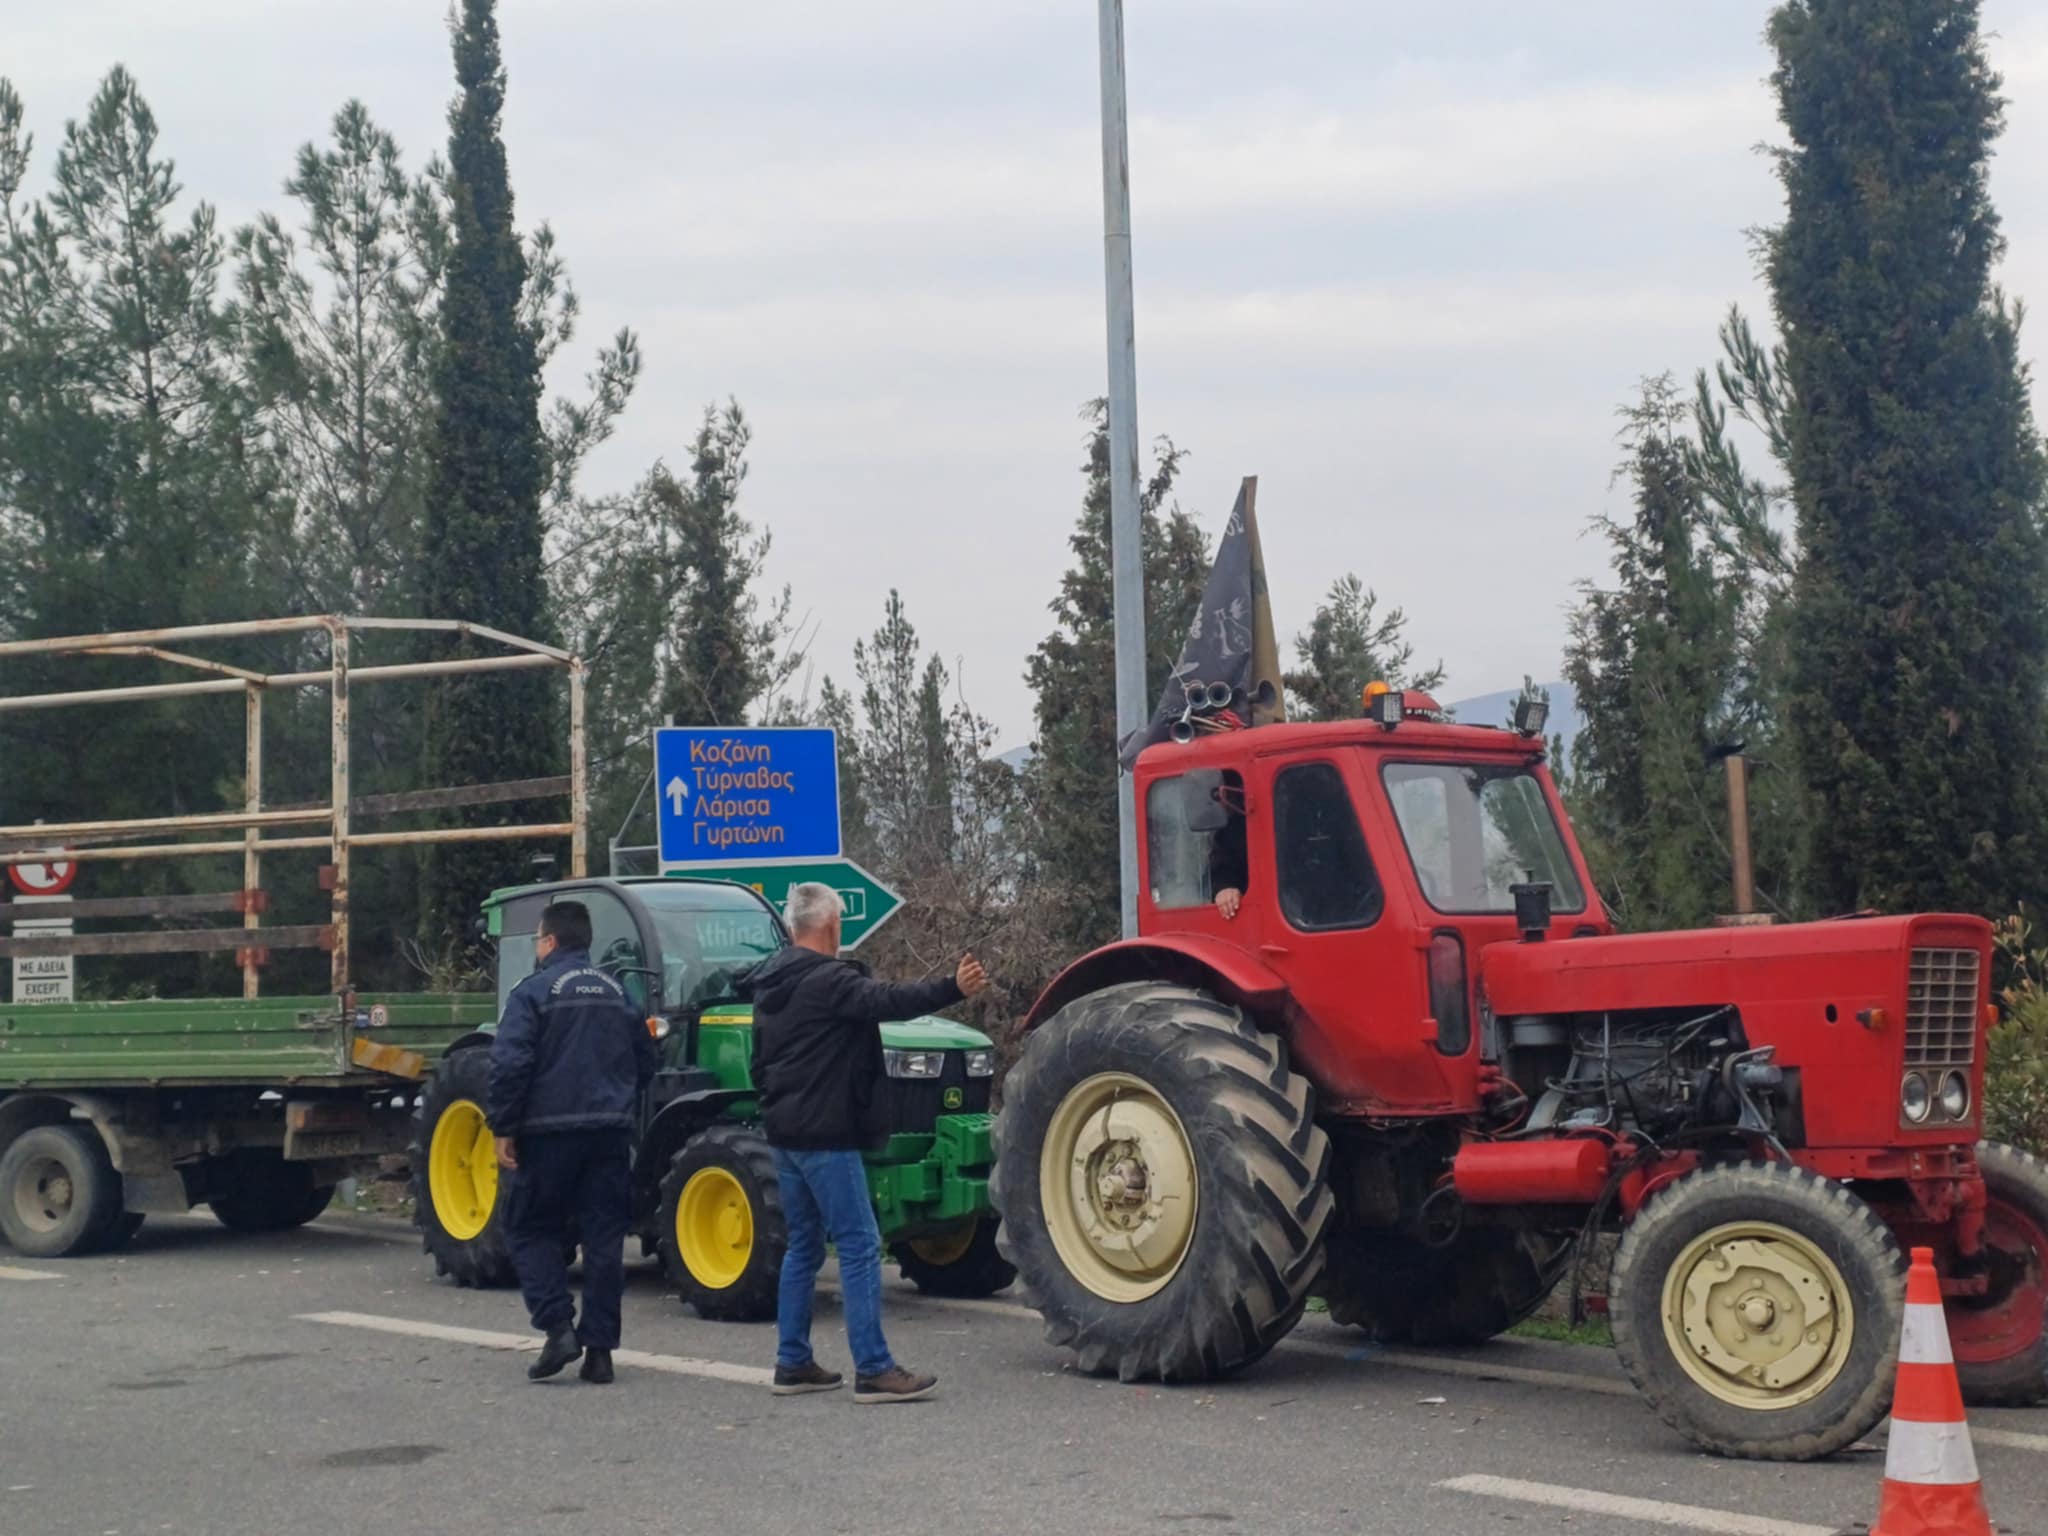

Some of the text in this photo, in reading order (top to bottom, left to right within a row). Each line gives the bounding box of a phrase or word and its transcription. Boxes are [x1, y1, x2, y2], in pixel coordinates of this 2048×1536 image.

[690, 739, 771, 768] Κοζάνη
[692, 767, 795, 795] Τύρναβος
[694, 794, 771, 822] Λάρισα
[693, 820, 785, 850] Γυρτώνη
[20, 960, 66, 974] ΜΕ ΑΔΕΙΑ
[25, 982, 60, 995] EXCEPT
[575, 985, 604, 994] POLICE
